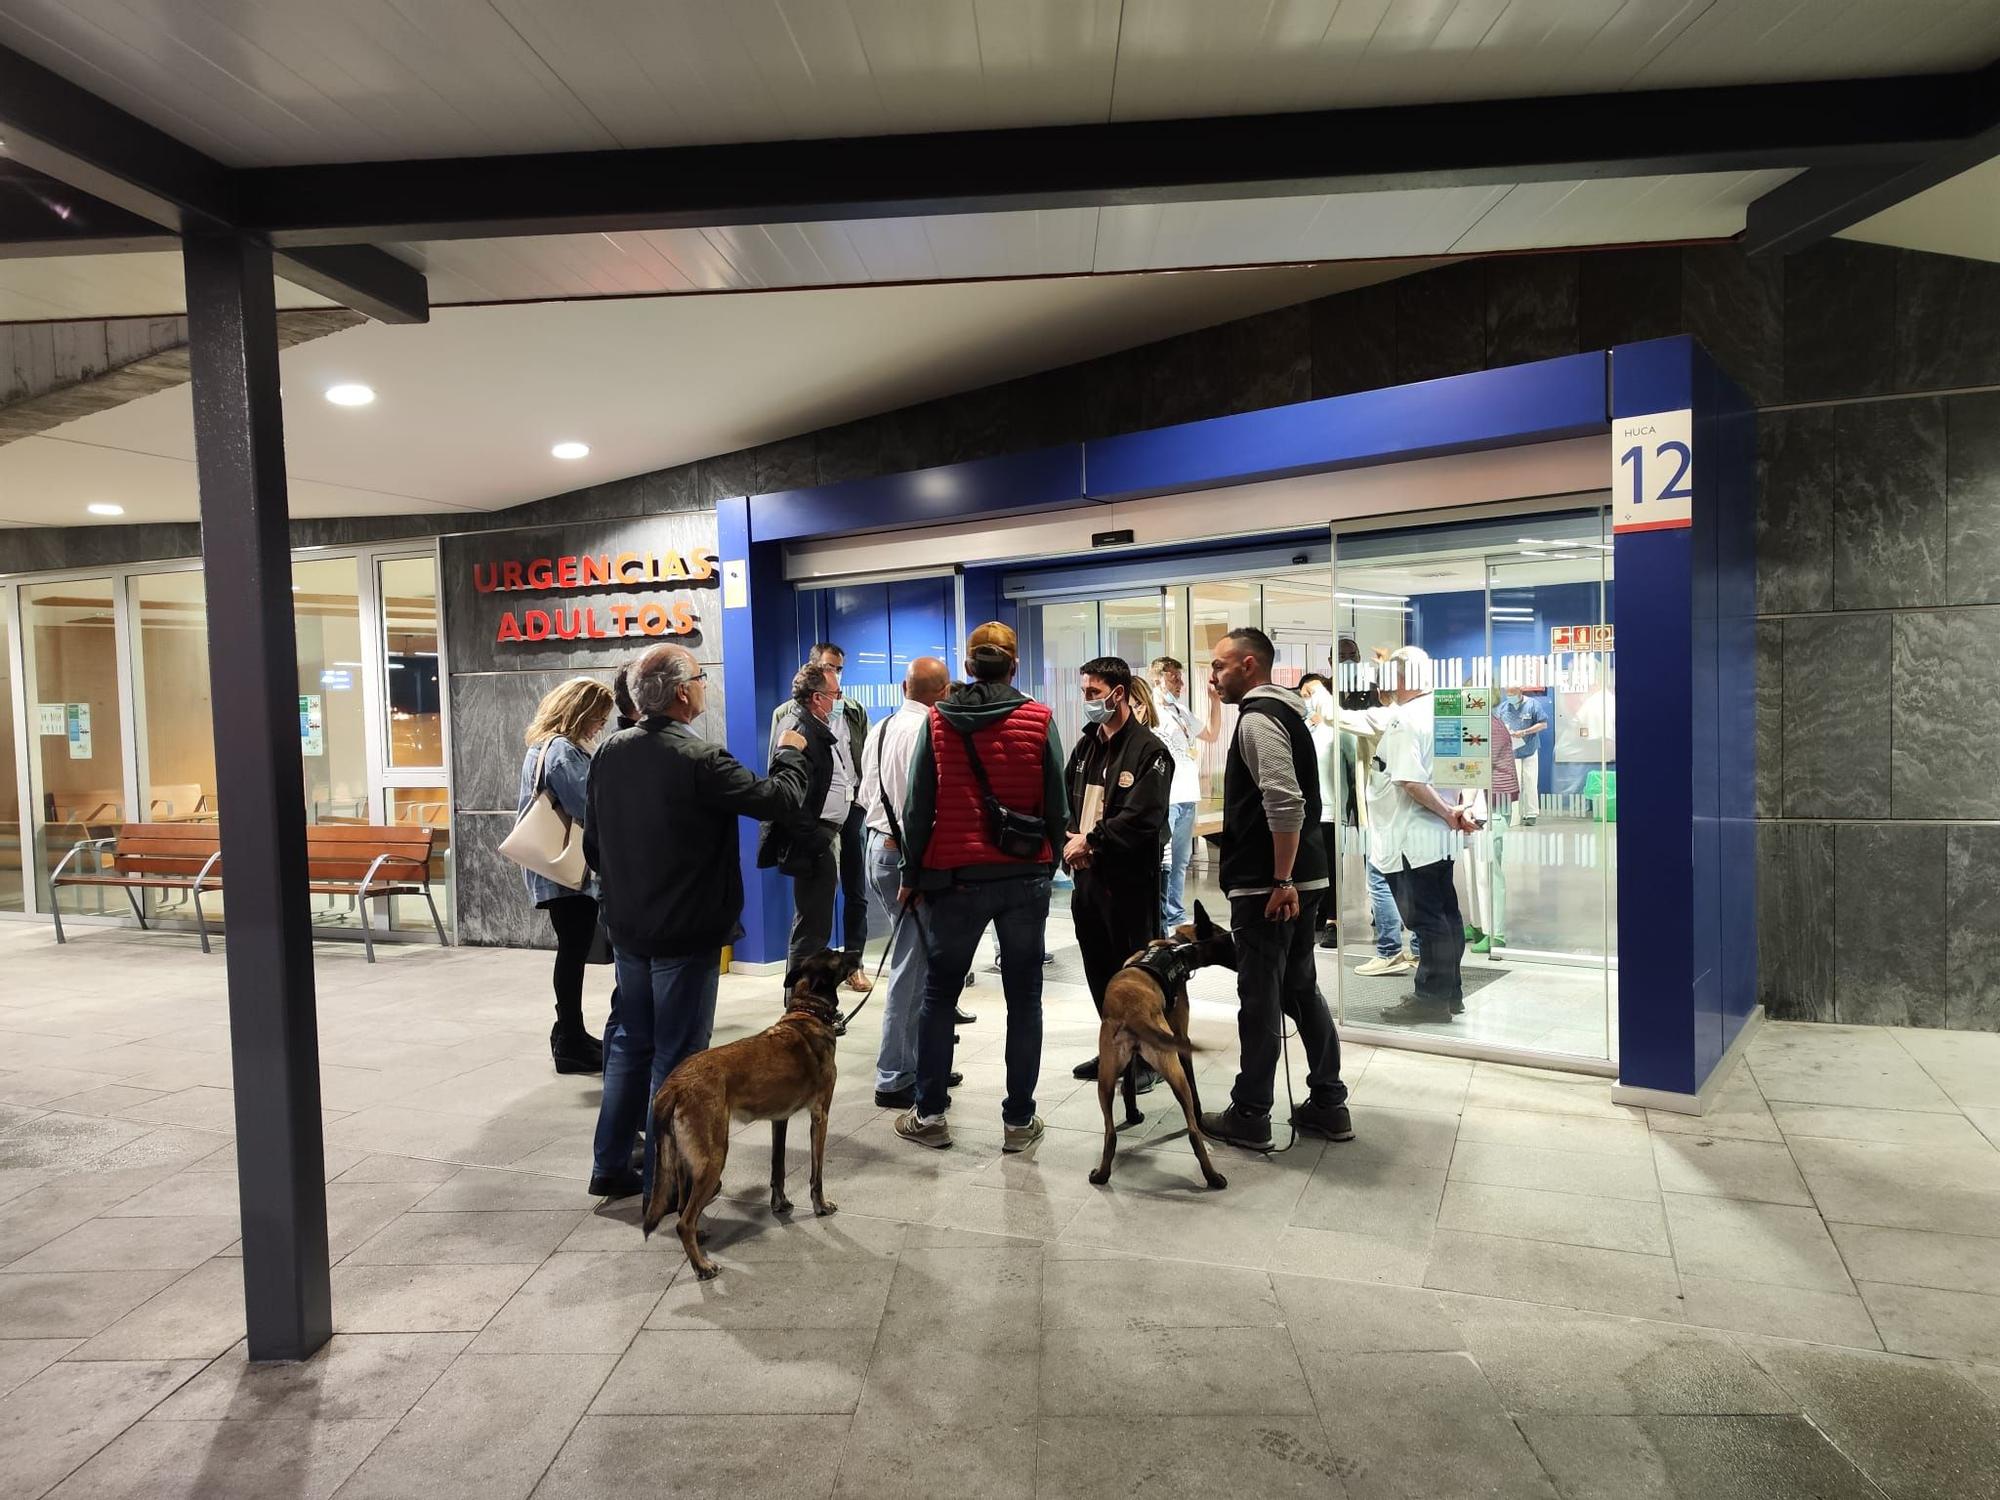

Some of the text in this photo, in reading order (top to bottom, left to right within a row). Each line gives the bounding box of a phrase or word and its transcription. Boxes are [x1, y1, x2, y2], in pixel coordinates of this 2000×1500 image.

[1624, 426, 1656, 437] HUCA
[1620, 441, 1692, 504] 12
[473, 548, 713, 592] URGENCIAS
[497, 602, 694, 642] ADULTOS
